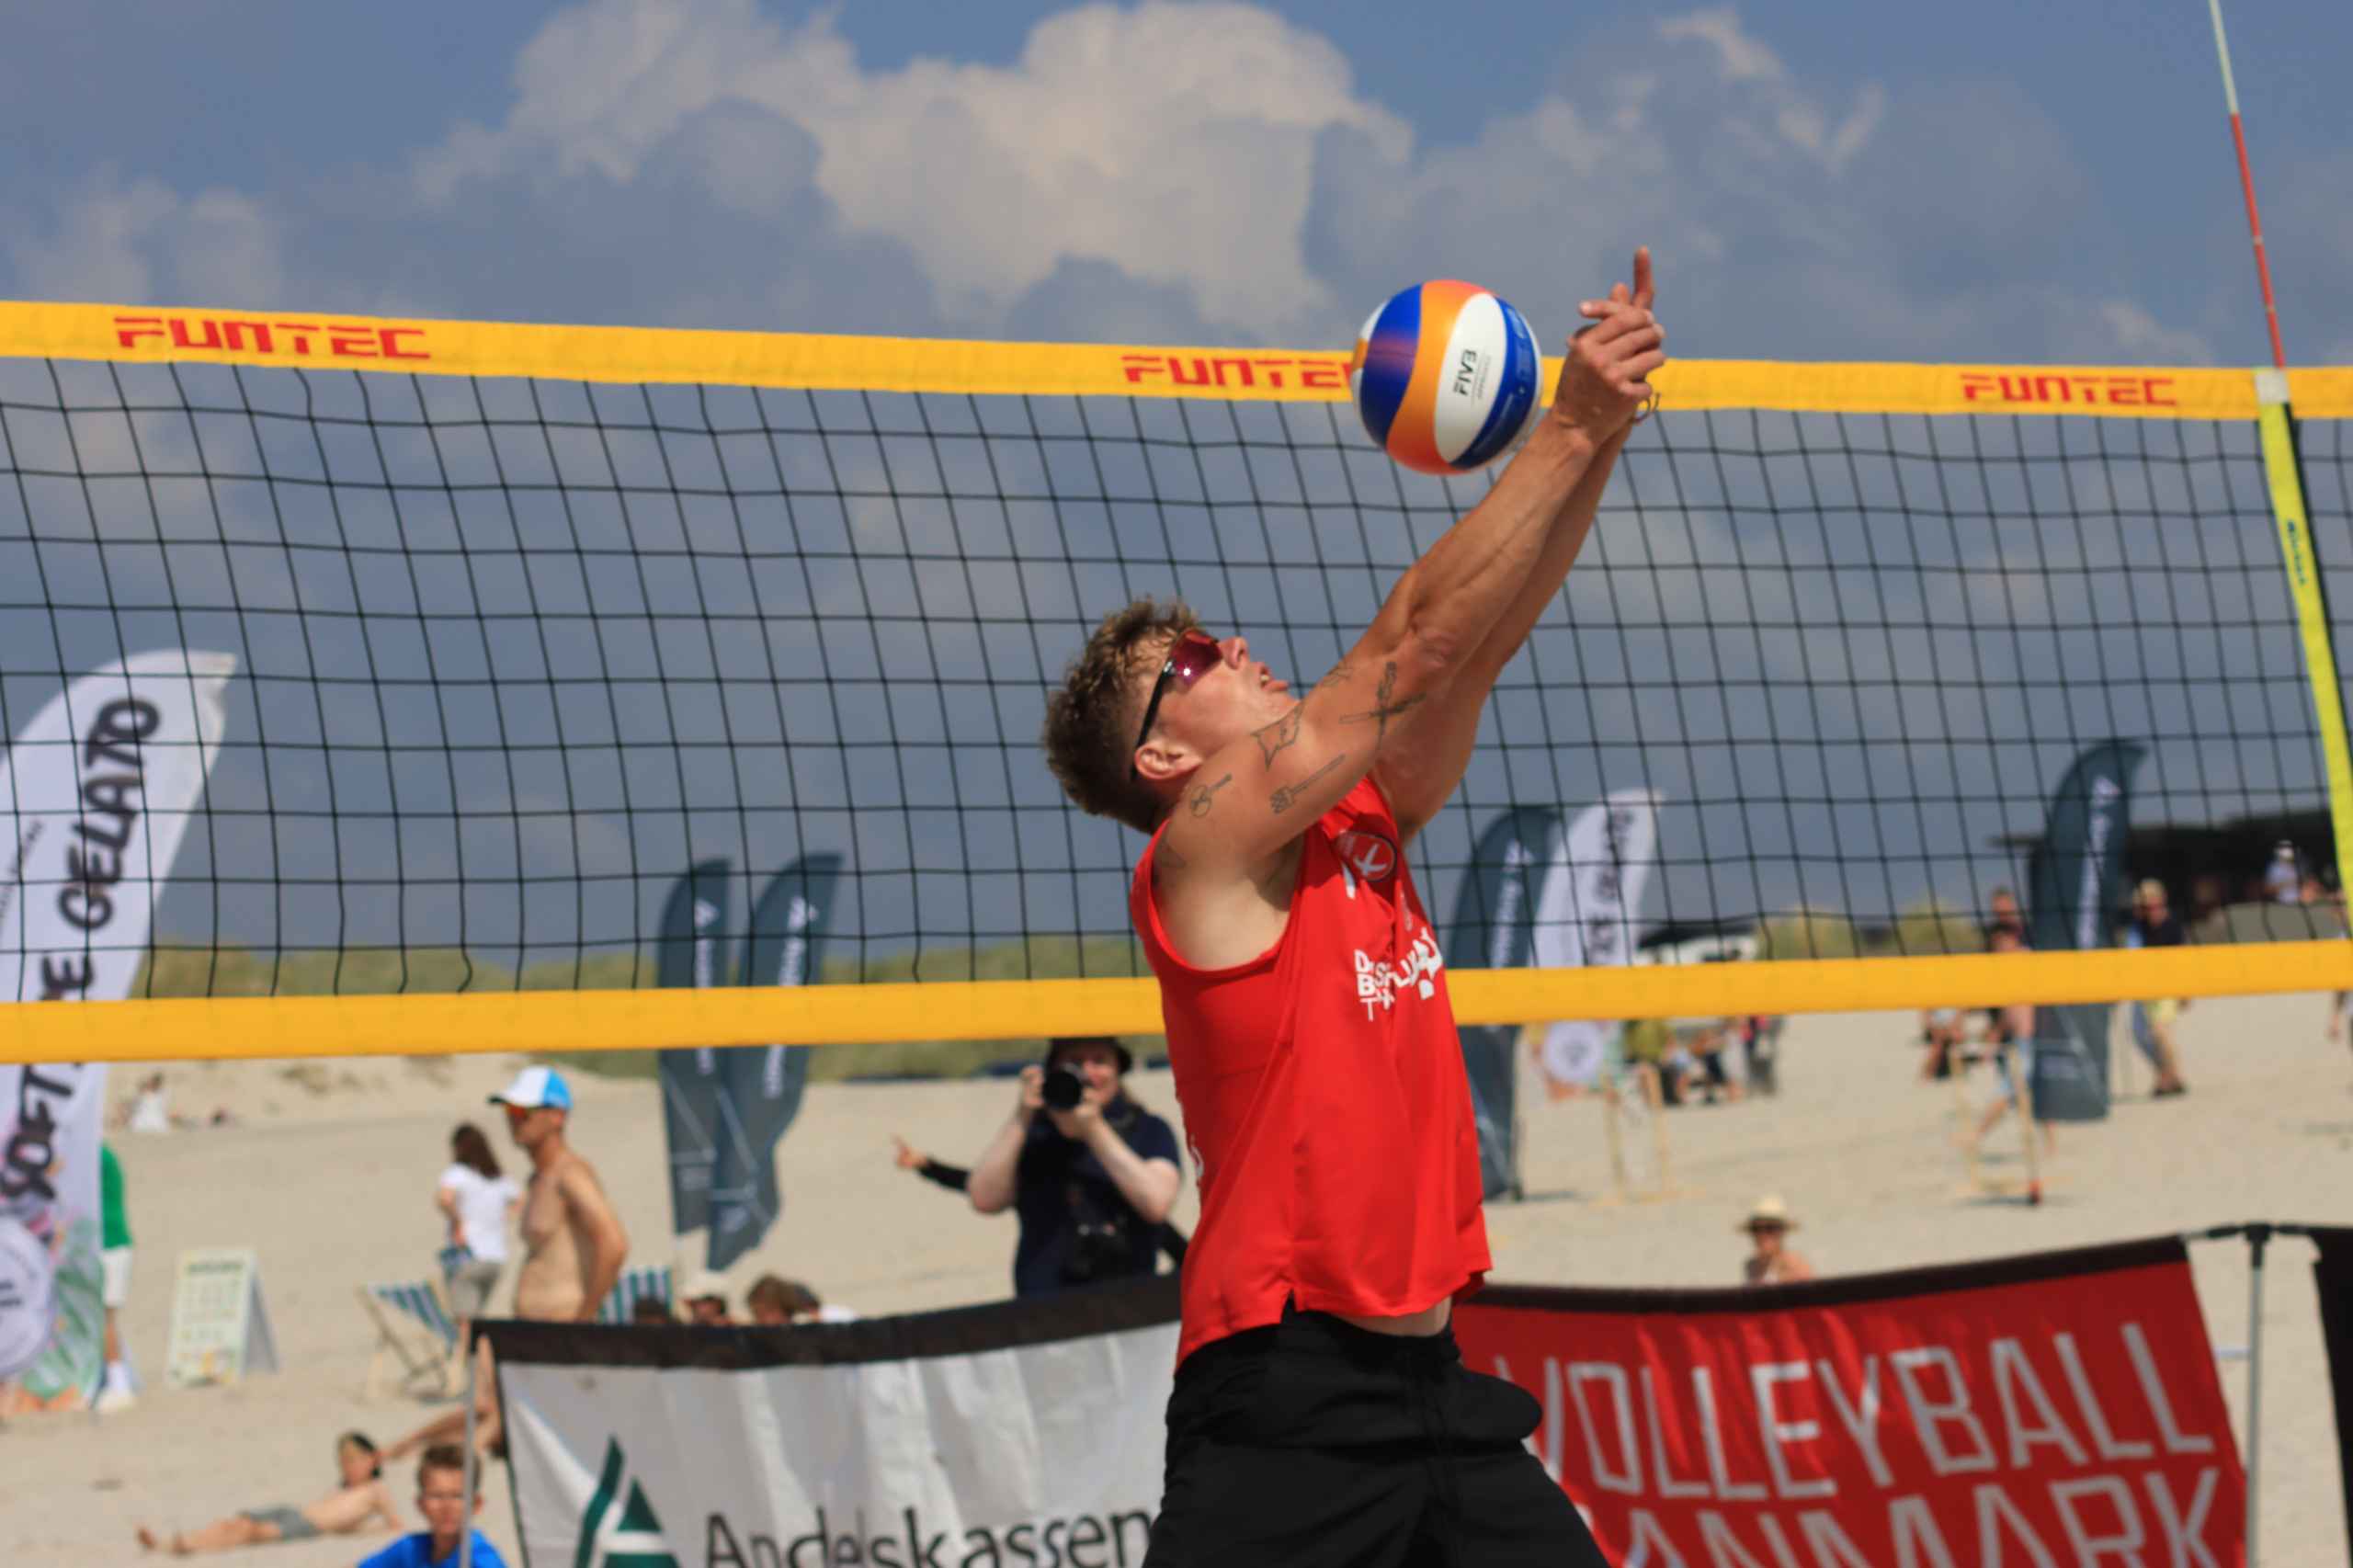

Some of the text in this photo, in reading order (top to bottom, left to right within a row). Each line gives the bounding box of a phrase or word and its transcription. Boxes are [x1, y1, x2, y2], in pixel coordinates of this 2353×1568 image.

[113, 316, 431, 360] FUNTEC
[1120, 355, 1353, 389] FUNTE
[1960, 373, 2178, 407] FUNTEC
[0, 1064, 73, 1200] SOFT
[57, 695, 161, 931] GELATO
[1493, 1322, 2216, 1499] VOLLEYBALL
[705, 1504, 1154, 1568] Andelskassen
[1575, 1467, 2221, 1568] ANMARK
